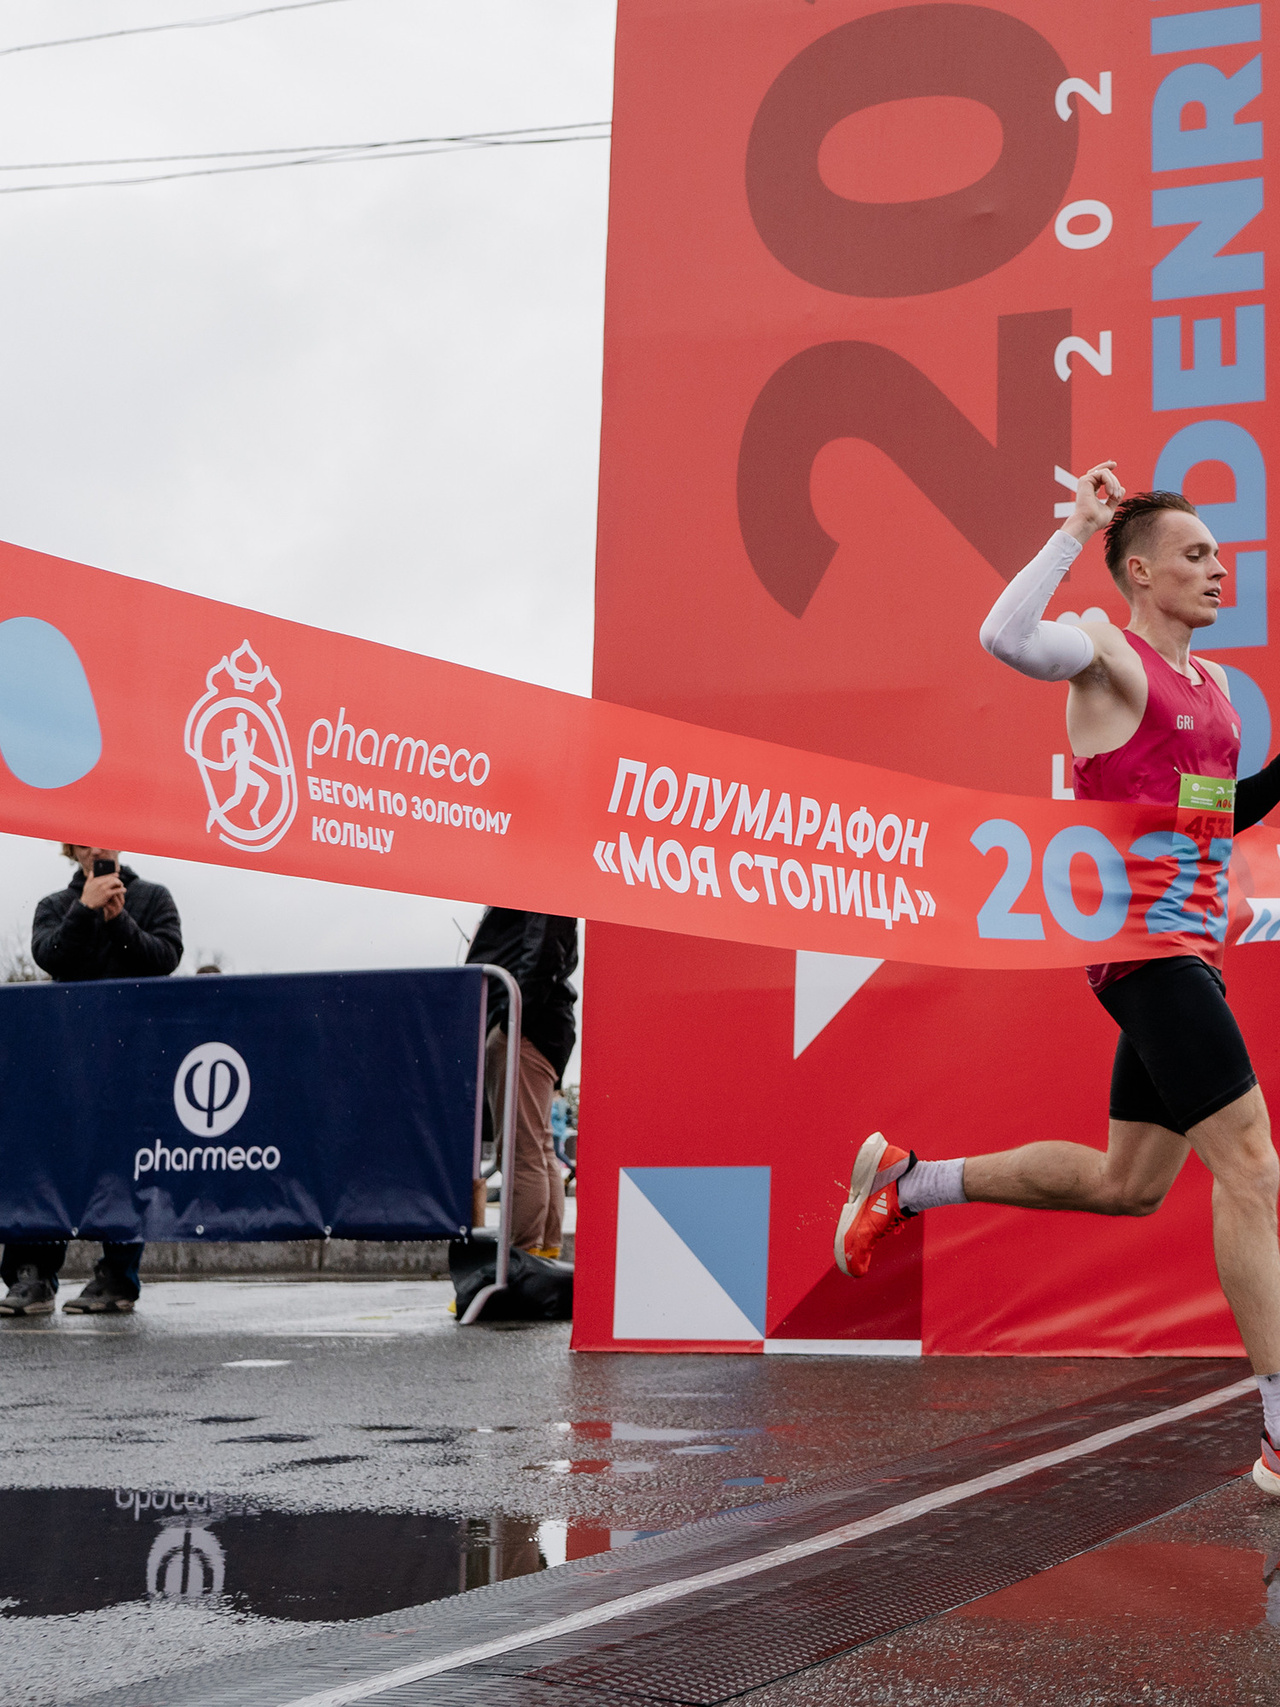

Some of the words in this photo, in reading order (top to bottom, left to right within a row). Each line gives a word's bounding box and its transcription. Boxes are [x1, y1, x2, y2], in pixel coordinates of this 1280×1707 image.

[307, 707, 490, 786] pharmeco
[307, 775, 374, 811] БЕГОМ
[378, 789, 408, 817] ПО
[411, 795, 512, 835] ЗОЛОТОМУ
[312, 816, 394, 854] КОЛЬЦУ
[607, 757, 929, 867] ПОЛУМАРАФОН
[593, 831, 722, 898] «МОЯ
[729, 851, 936, 930] СТОЛИЦА»
[134, 1139, 281, 1180] pharmeco
